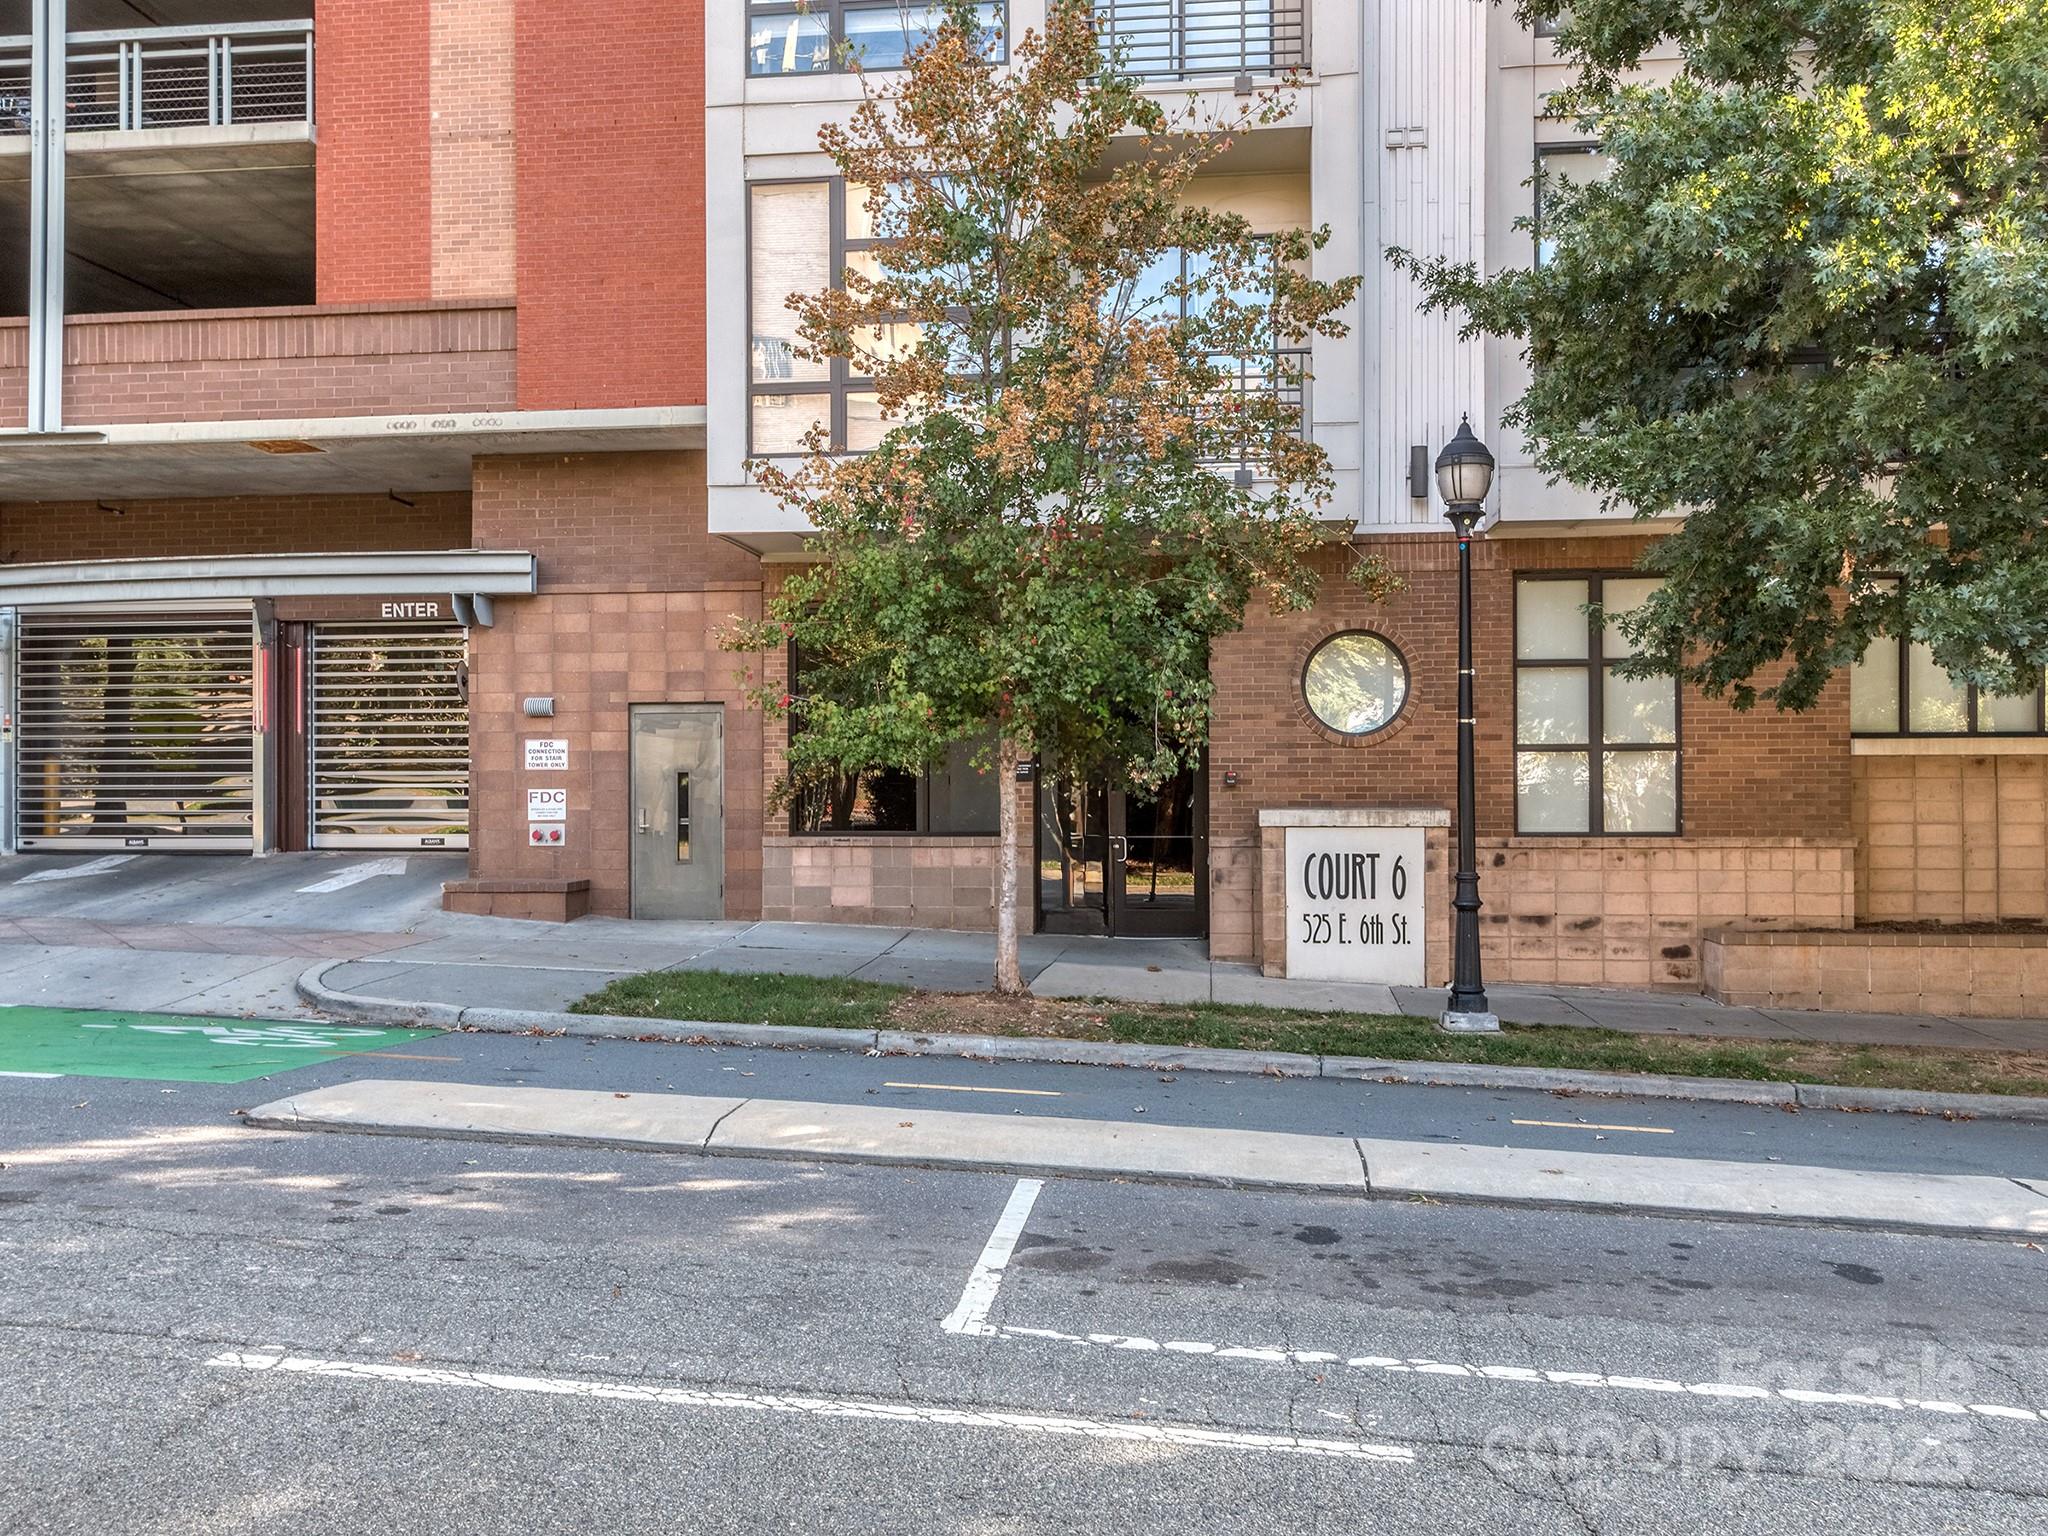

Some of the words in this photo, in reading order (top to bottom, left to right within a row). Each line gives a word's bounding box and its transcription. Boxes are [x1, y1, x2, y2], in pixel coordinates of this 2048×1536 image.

[381, 602, 438, 618] ENTER
[529, 791, 565, 804] FDC
[1303, 852, 1380, 900] COURT
[1392, 855, 1407, 900] 6
[1302, 913, 1332, 944] 525
[1339, 913, 1352, 944] E.
[1360, 913, 1384, 944] 6th
[1392, 913, 1411, 944] St.
